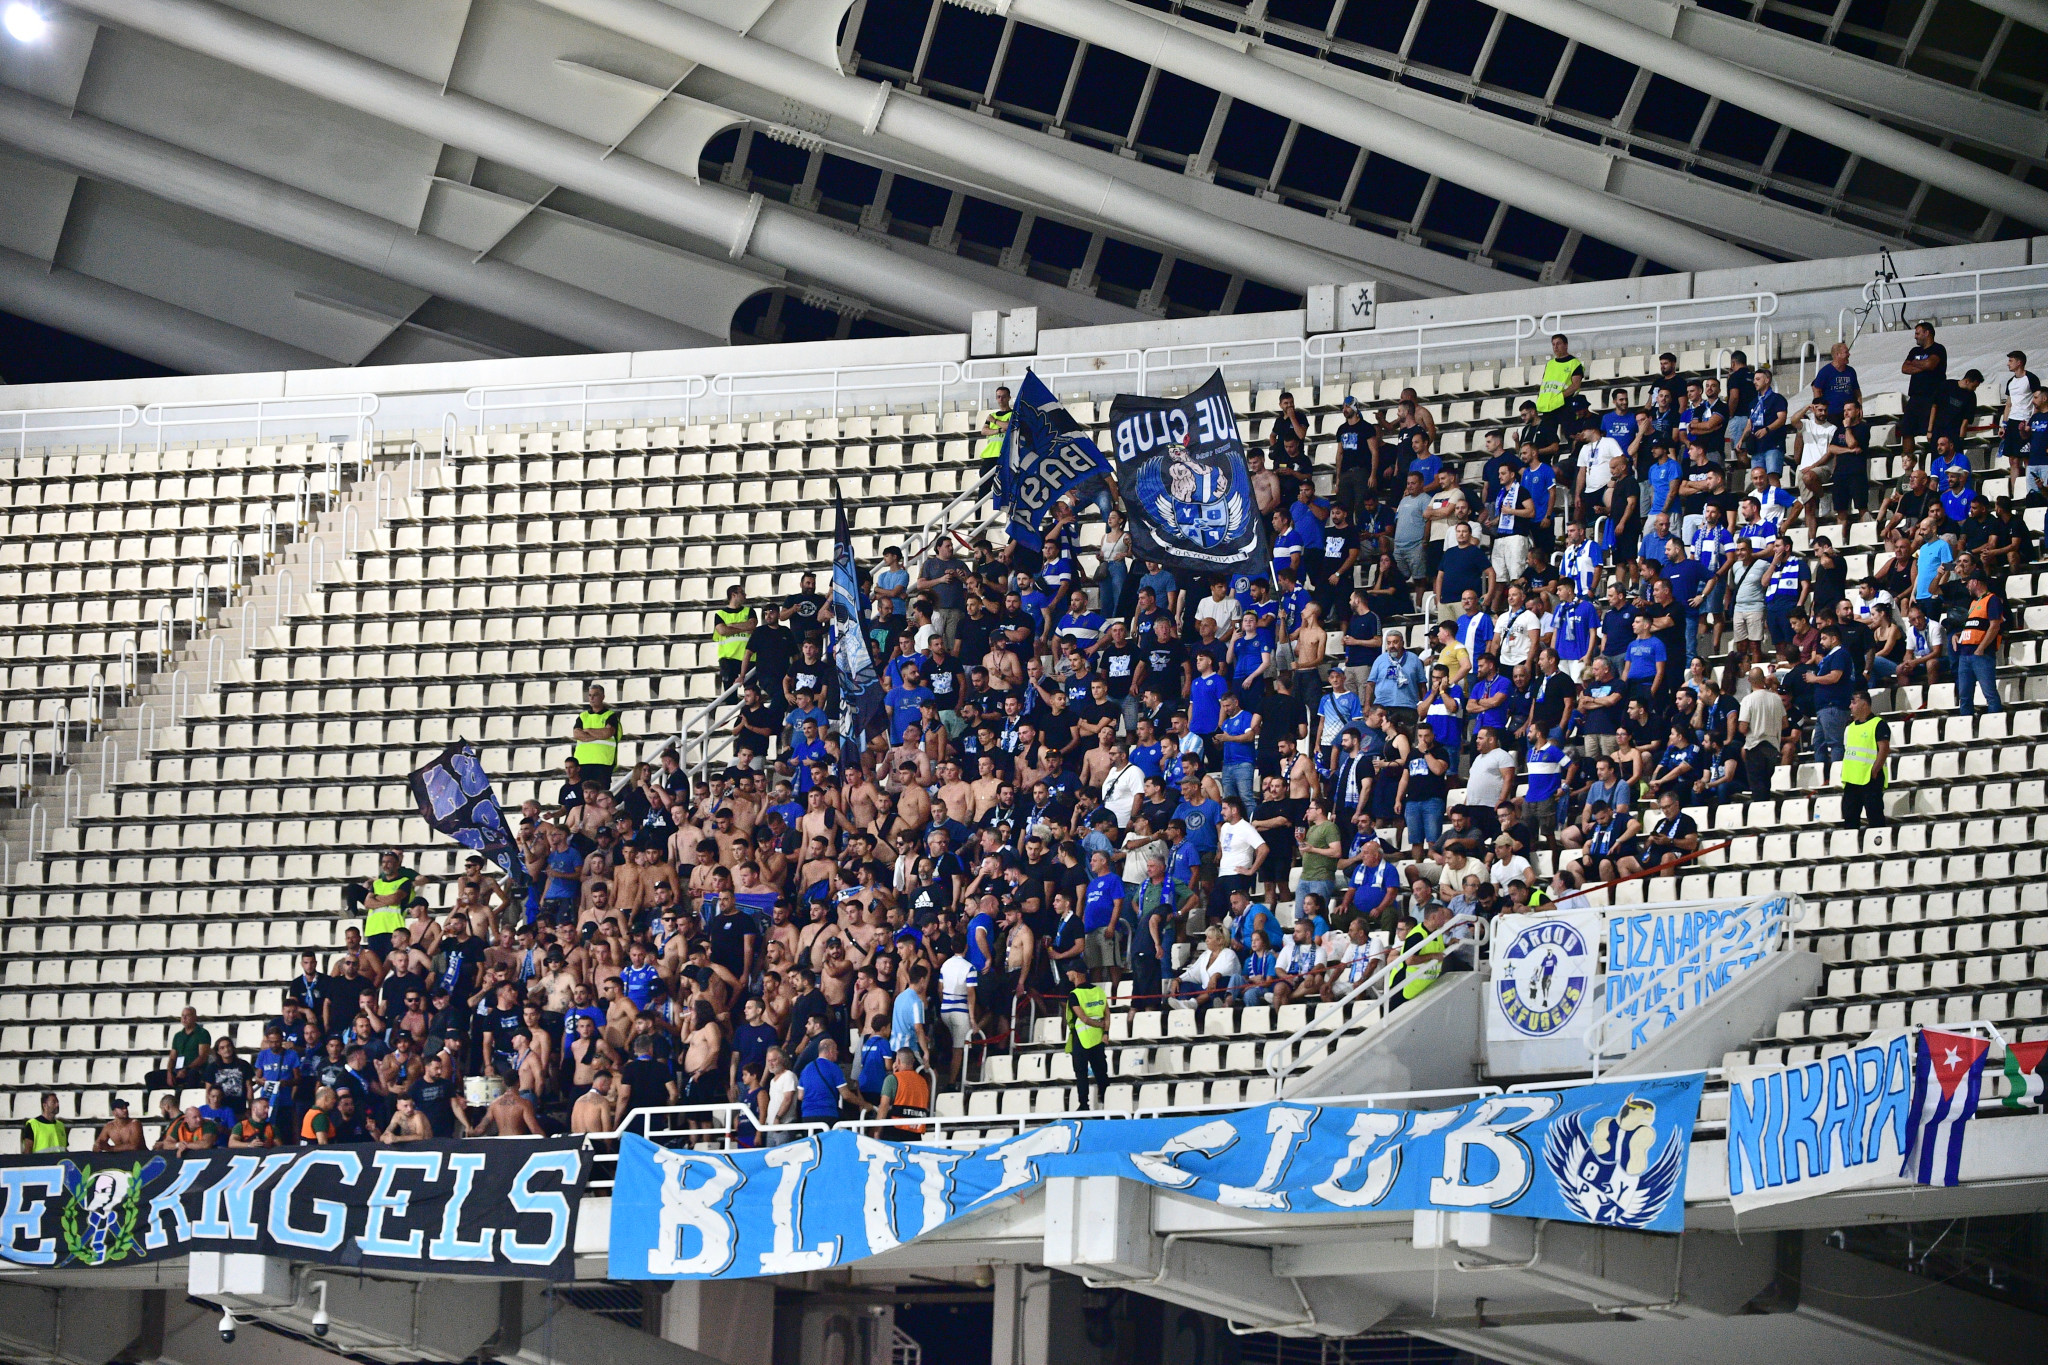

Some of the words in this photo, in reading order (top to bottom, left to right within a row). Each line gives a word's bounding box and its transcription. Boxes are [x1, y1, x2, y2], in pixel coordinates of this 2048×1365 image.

[1517, 925, 1578, 956] PROUD
[1501, 986, 1581, 1032] REFUGEES
[1129, 1091, 1565, 1212] CLUB
[144, 1148, 583, 1266] ANGELS
